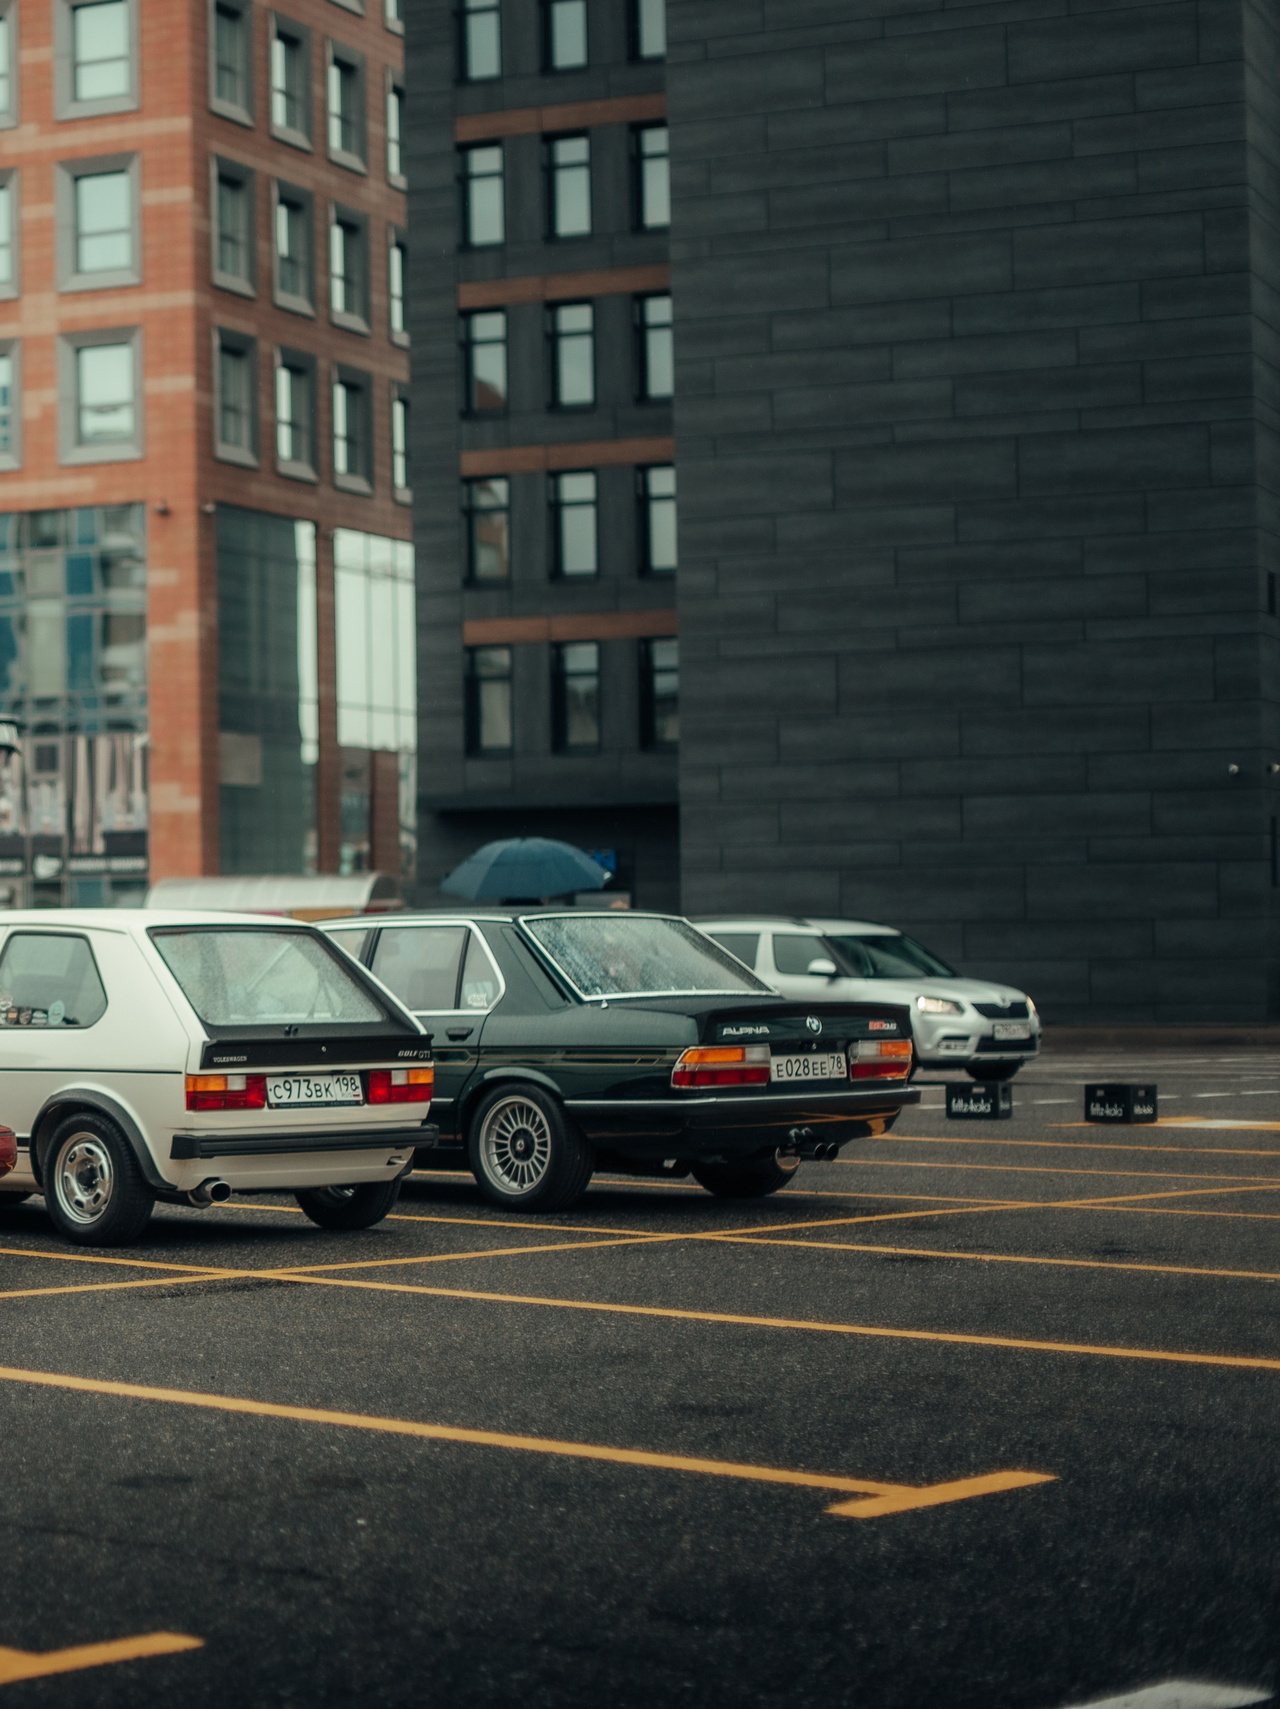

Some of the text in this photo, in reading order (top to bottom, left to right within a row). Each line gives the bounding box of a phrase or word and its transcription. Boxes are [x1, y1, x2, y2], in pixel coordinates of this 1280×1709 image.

[722, 1026, 770, 1036] ALPINA
[418, 1050, 431, 1059] GTI
[829, 1055, 843, 1070] 78
[334, 1076, 358, 1092] 198
[951, 1096, 992, 1114] fritz-kola
[1090, 1102, 1124, 1117] fritz-kola
